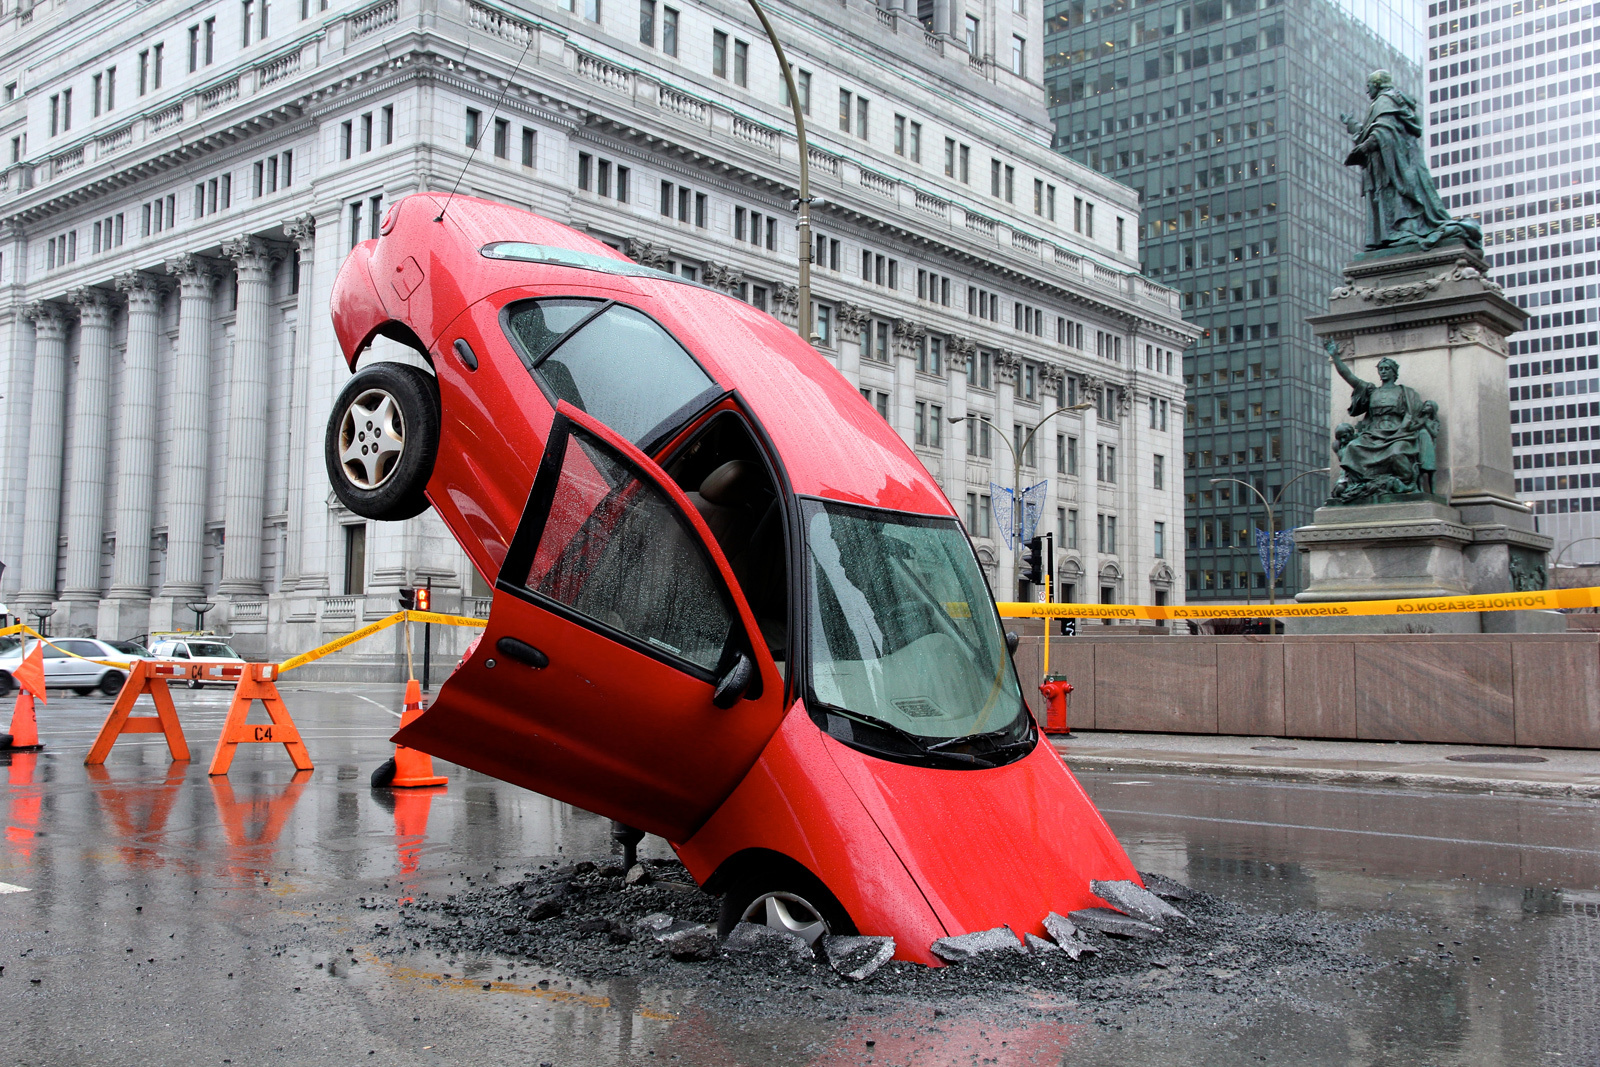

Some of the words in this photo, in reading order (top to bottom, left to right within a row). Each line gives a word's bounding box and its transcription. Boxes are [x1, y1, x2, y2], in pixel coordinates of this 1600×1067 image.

[1378, 332, 1424, 346] RELIGION
[191, 664, 203, 679] C4
[254, 727, 273, 741] C4
